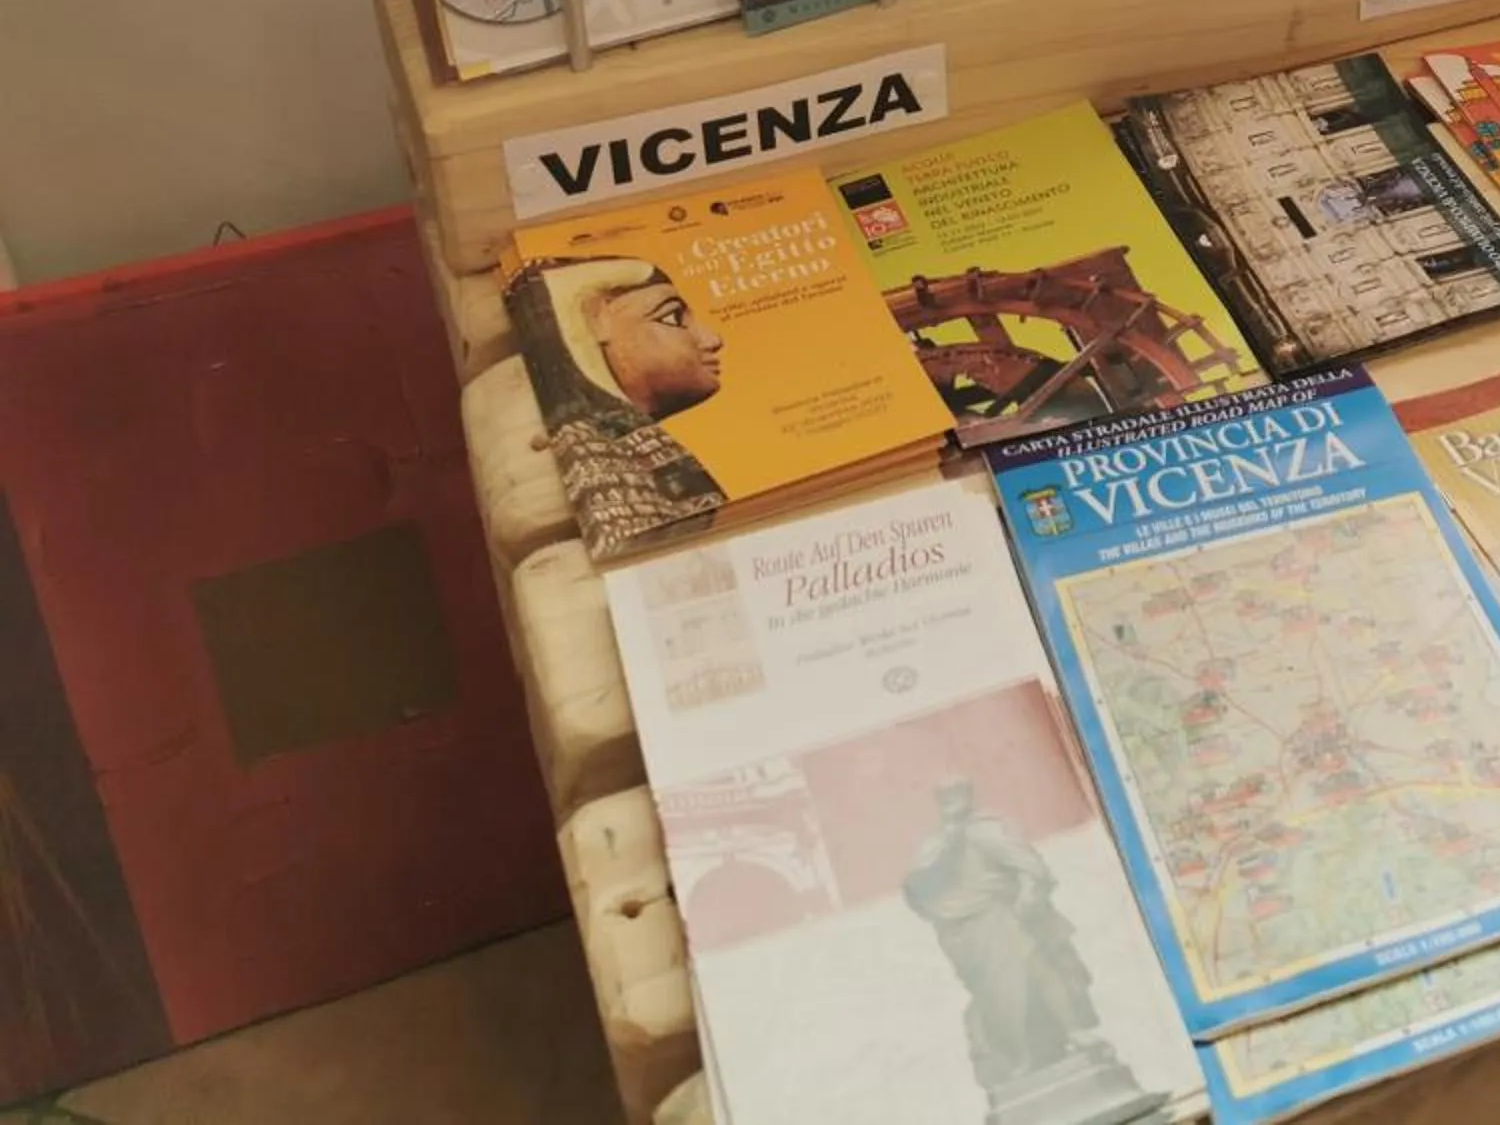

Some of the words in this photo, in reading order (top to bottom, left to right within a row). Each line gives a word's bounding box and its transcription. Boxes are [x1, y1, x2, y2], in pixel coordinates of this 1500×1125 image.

[540, 73, 923, 196] VICENZA
[913, 161, 1019, 196] ARCHITETTURA
[925, 206, 955, 219] NEL
[958, 189, 1012, 211] VENETO
[931, 214, 963, 229] DEL
[964, 183, 1071, 221] RINASCIMENTO
[690, 211, 828, 260] Creatori
[707, 258, 830, 299] Eterno
[1002, 434, 1068, 456] CARTA
[1072, 409, 1177, 443] STRADALE
[1174, 382, 1288, 418] ILLUSTRATA
[1287, 367, 1354, 393] DELLA
[1057, 418, 1187, 457] ILLUSTRATED
[1189, 406, 1245, 427] ROAD
[1247, 397, 1288, 416] MAP
[1290, 389, 1318, 407] OF
[1060, 414, 1291, 488] PROVINCIA
[1294, 401, 1344, 431] DI
[1077, 431, 1366, 524] VICENZA
[848, 529, 886, 553] Den
[785, 541, 945, 607] Palladios
